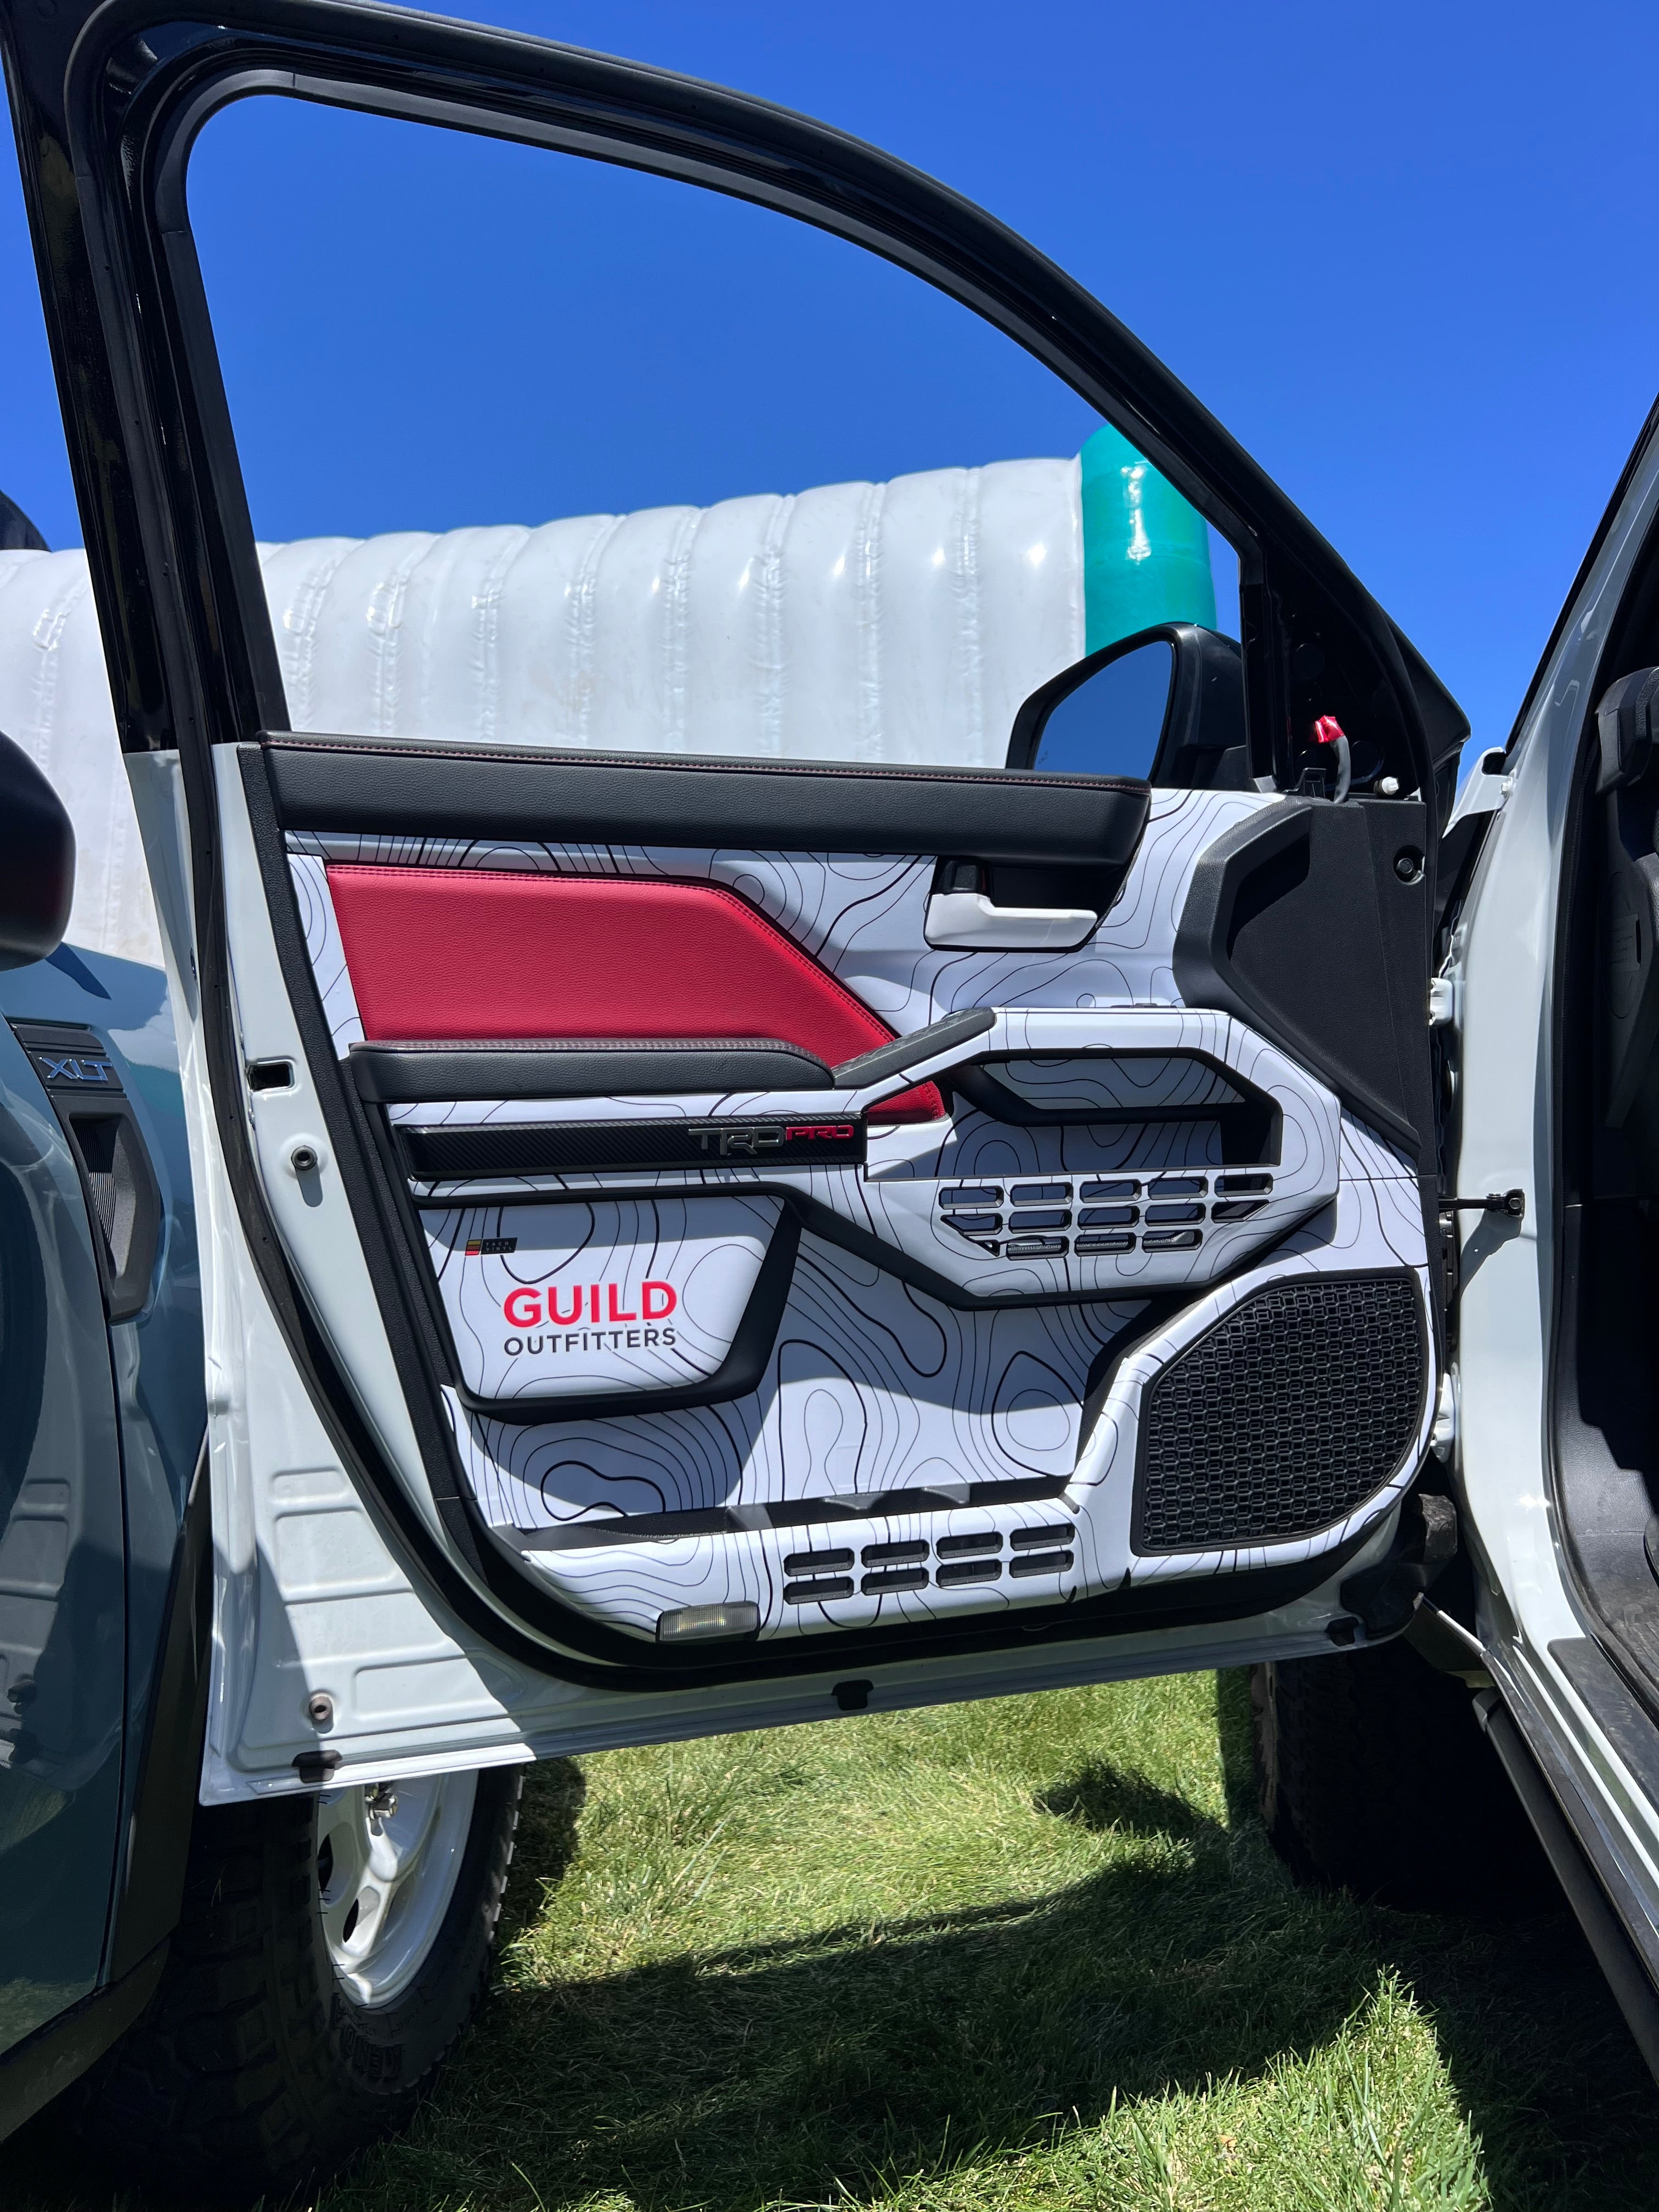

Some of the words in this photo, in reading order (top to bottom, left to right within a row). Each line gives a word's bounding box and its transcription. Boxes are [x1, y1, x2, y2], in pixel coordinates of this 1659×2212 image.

[39, 1057, 112, 1081] XLT
[688, 1126, 785, 1156] TRD
[786, 1125, 854, 1141] PRO
[504, 1281, 678, 1328] GUILD
[504, 1327, 676, 1356] OUTFITTERS
